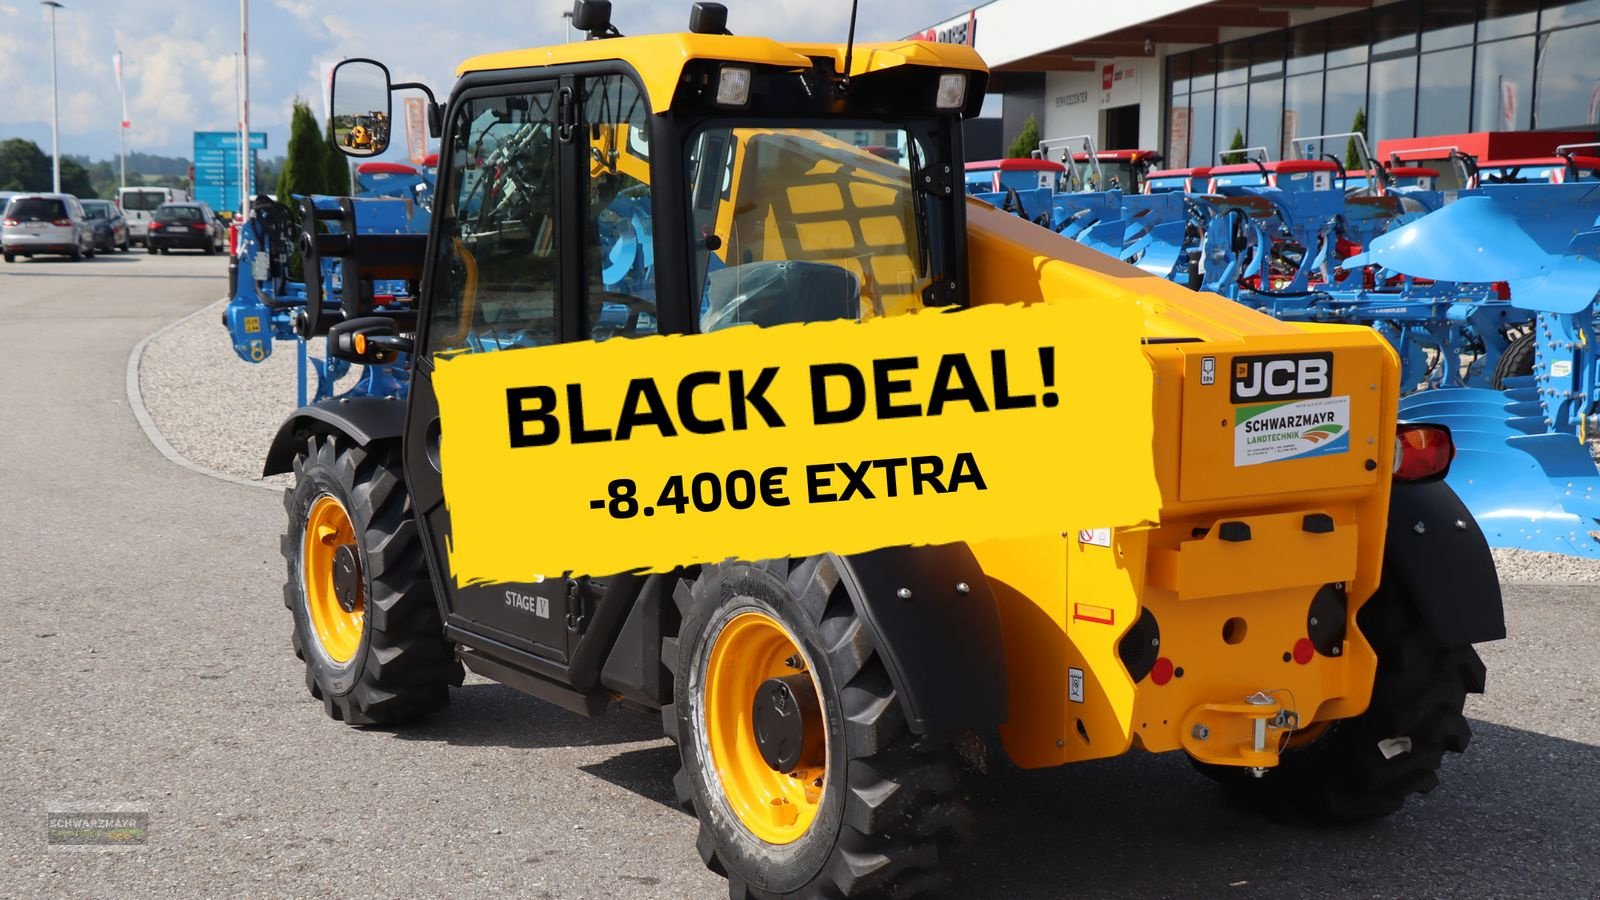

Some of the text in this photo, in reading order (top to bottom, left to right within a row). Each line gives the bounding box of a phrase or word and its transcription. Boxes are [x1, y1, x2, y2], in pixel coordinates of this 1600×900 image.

[1236, 358, 1328, 398] JCB
[1245, 411, 1335, 433] SCHWARZMAYR
[1247, 431, 1300, 445] LANDTECHNIK
[505, 590, 535, 612] STAGE
